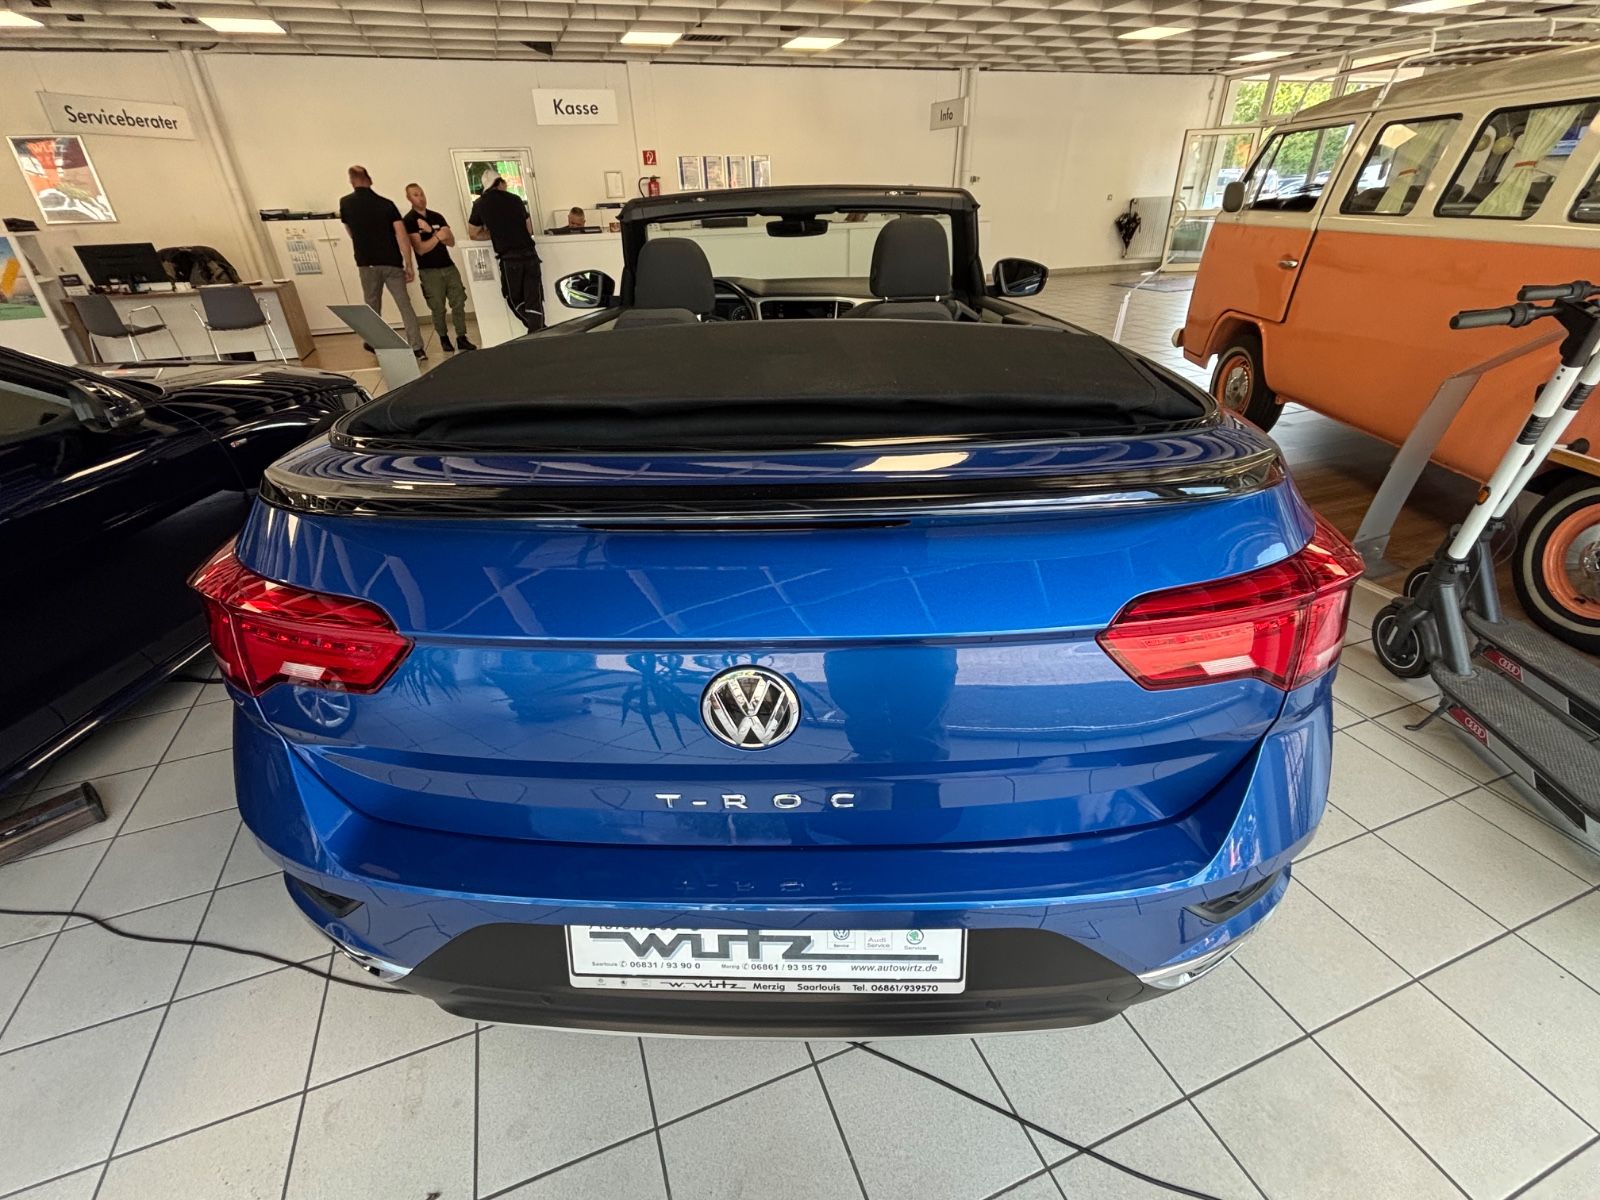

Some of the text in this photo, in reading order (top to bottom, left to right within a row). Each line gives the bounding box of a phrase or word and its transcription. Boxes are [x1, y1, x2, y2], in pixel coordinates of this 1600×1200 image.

[553, 98, 599, 115] Kasse
[64, 105, 178, 130] Serviceberater
[940, 107, 954, 121] Info
[655, 792, 855, 809] T-ROC
[751, 963, 779, 971] 06861
[816, 964, 828, 972] 70
[850, 963, 938, 973] www.autowirtz.de
[752, 983, 786, 992] Merzig
[797, 983, 841, 992] Saarlouis
[852, 984, 939, 993] Tel. 06861/939570
